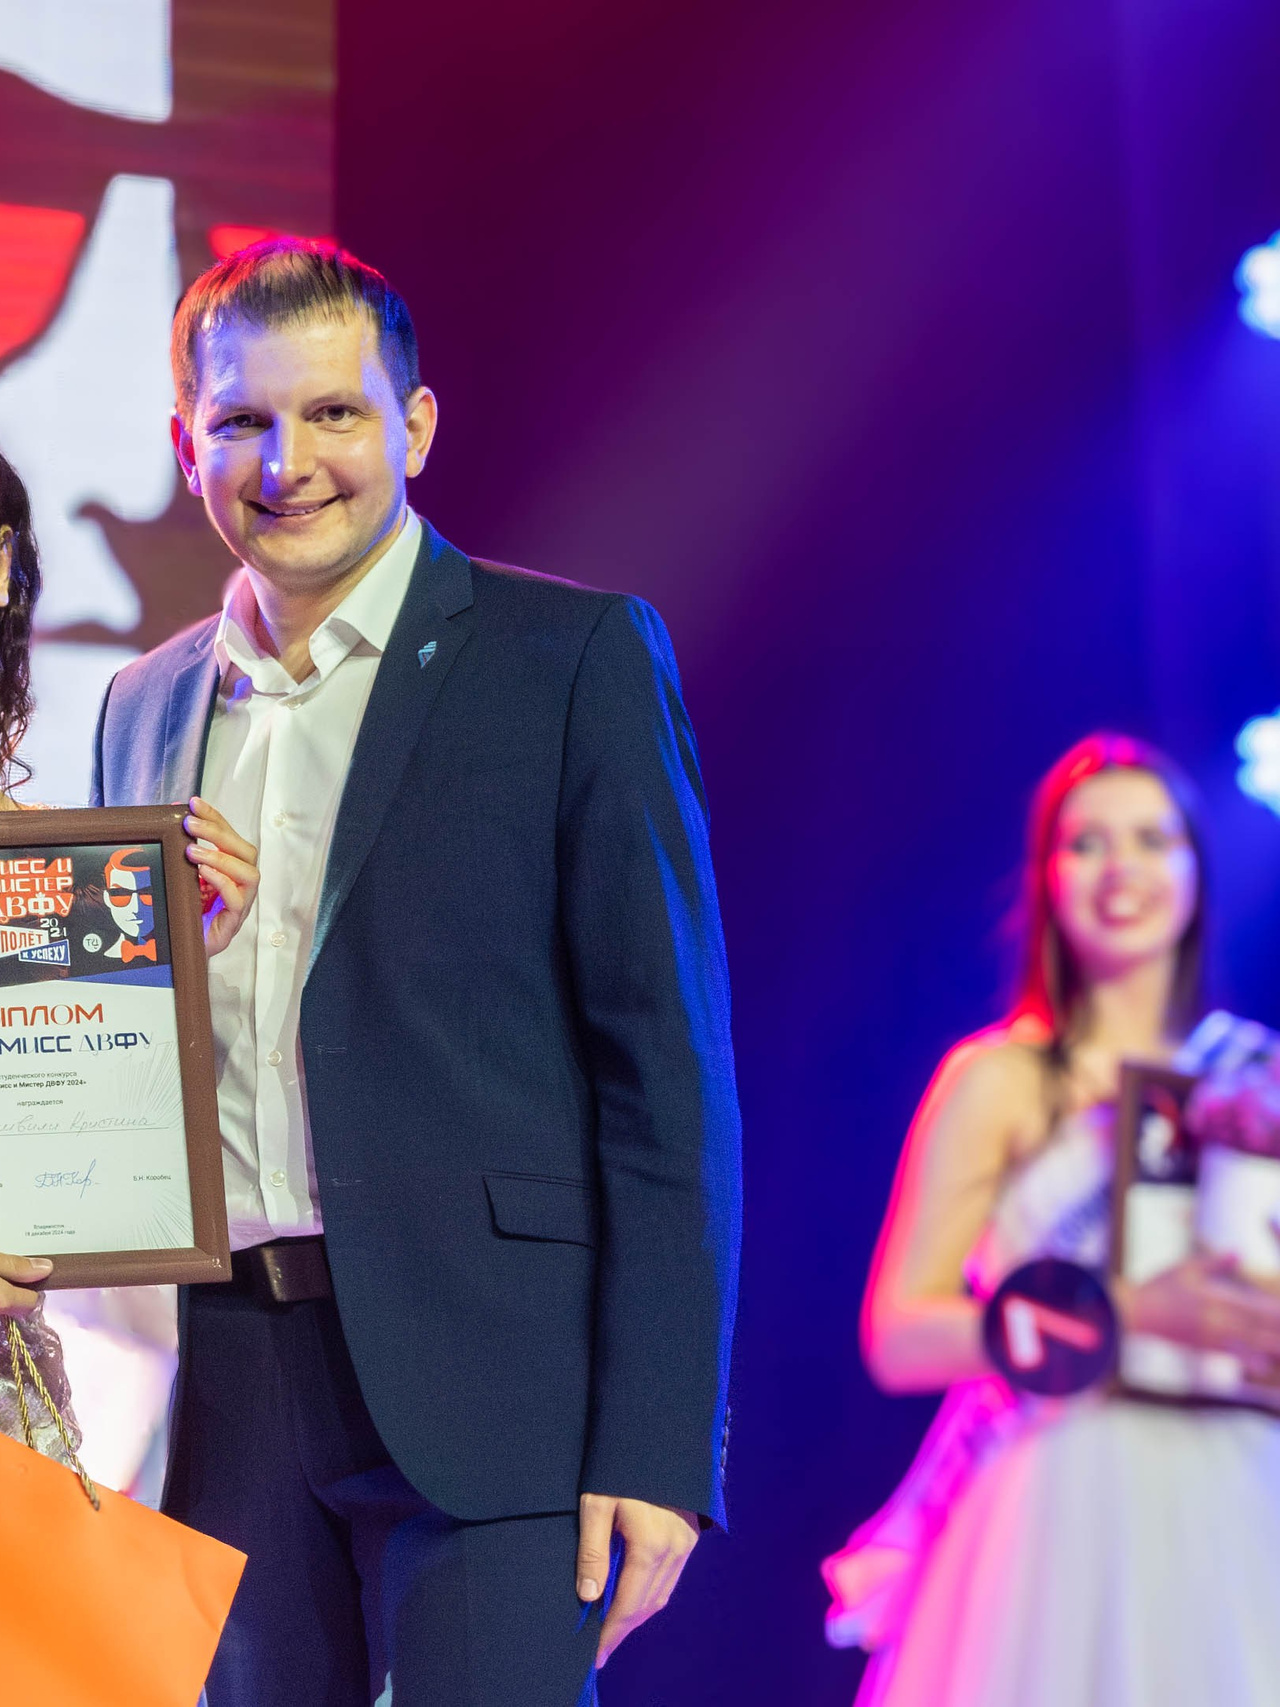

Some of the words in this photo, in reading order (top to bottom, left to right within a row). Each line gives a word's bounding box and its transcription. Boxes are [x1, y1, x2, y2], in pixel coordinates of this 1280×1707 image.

[57, 857, 72, 873] И
[40, 917, 59, 928] 20
[31, 944, 66, 961] УСПЕХУ
[78, 1032, 153, 1057] ДВФУ
[47, 1071, 78, 1079] конкурса
[19, 1081, 44, 1089] Мистер
[45, 1079, 65, 1088] ДВФУ
[16, 1099, 64, 1107] награждается
